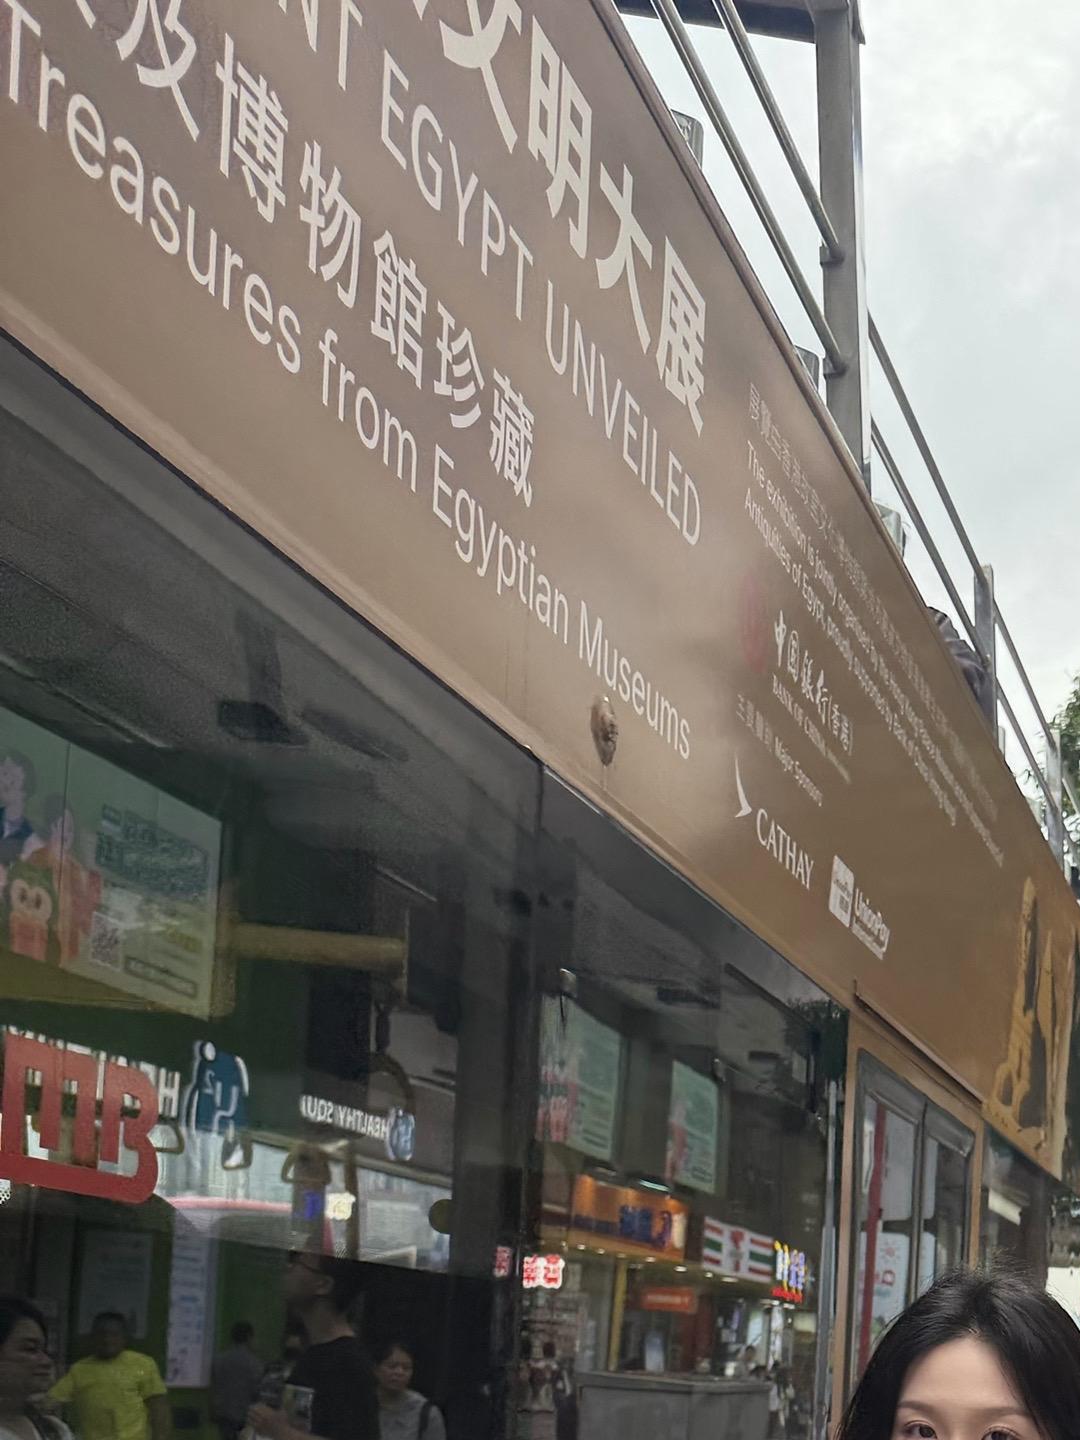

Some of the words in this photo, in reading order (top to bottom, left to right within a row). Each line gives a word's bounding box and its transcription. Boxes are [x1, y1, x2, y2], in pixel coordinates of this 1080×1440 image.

[2, 0, 302, 375] Treasures
[318, 332, 418, 493] from
[432, 445, 570, 646] Egyptian
[578, 600, 692, 761] Museums
[380, 48, 534, 320] EGYPT
[545, 279, 700, 546] UNVEILED
[757, 808, 815, 890] CATHAY
